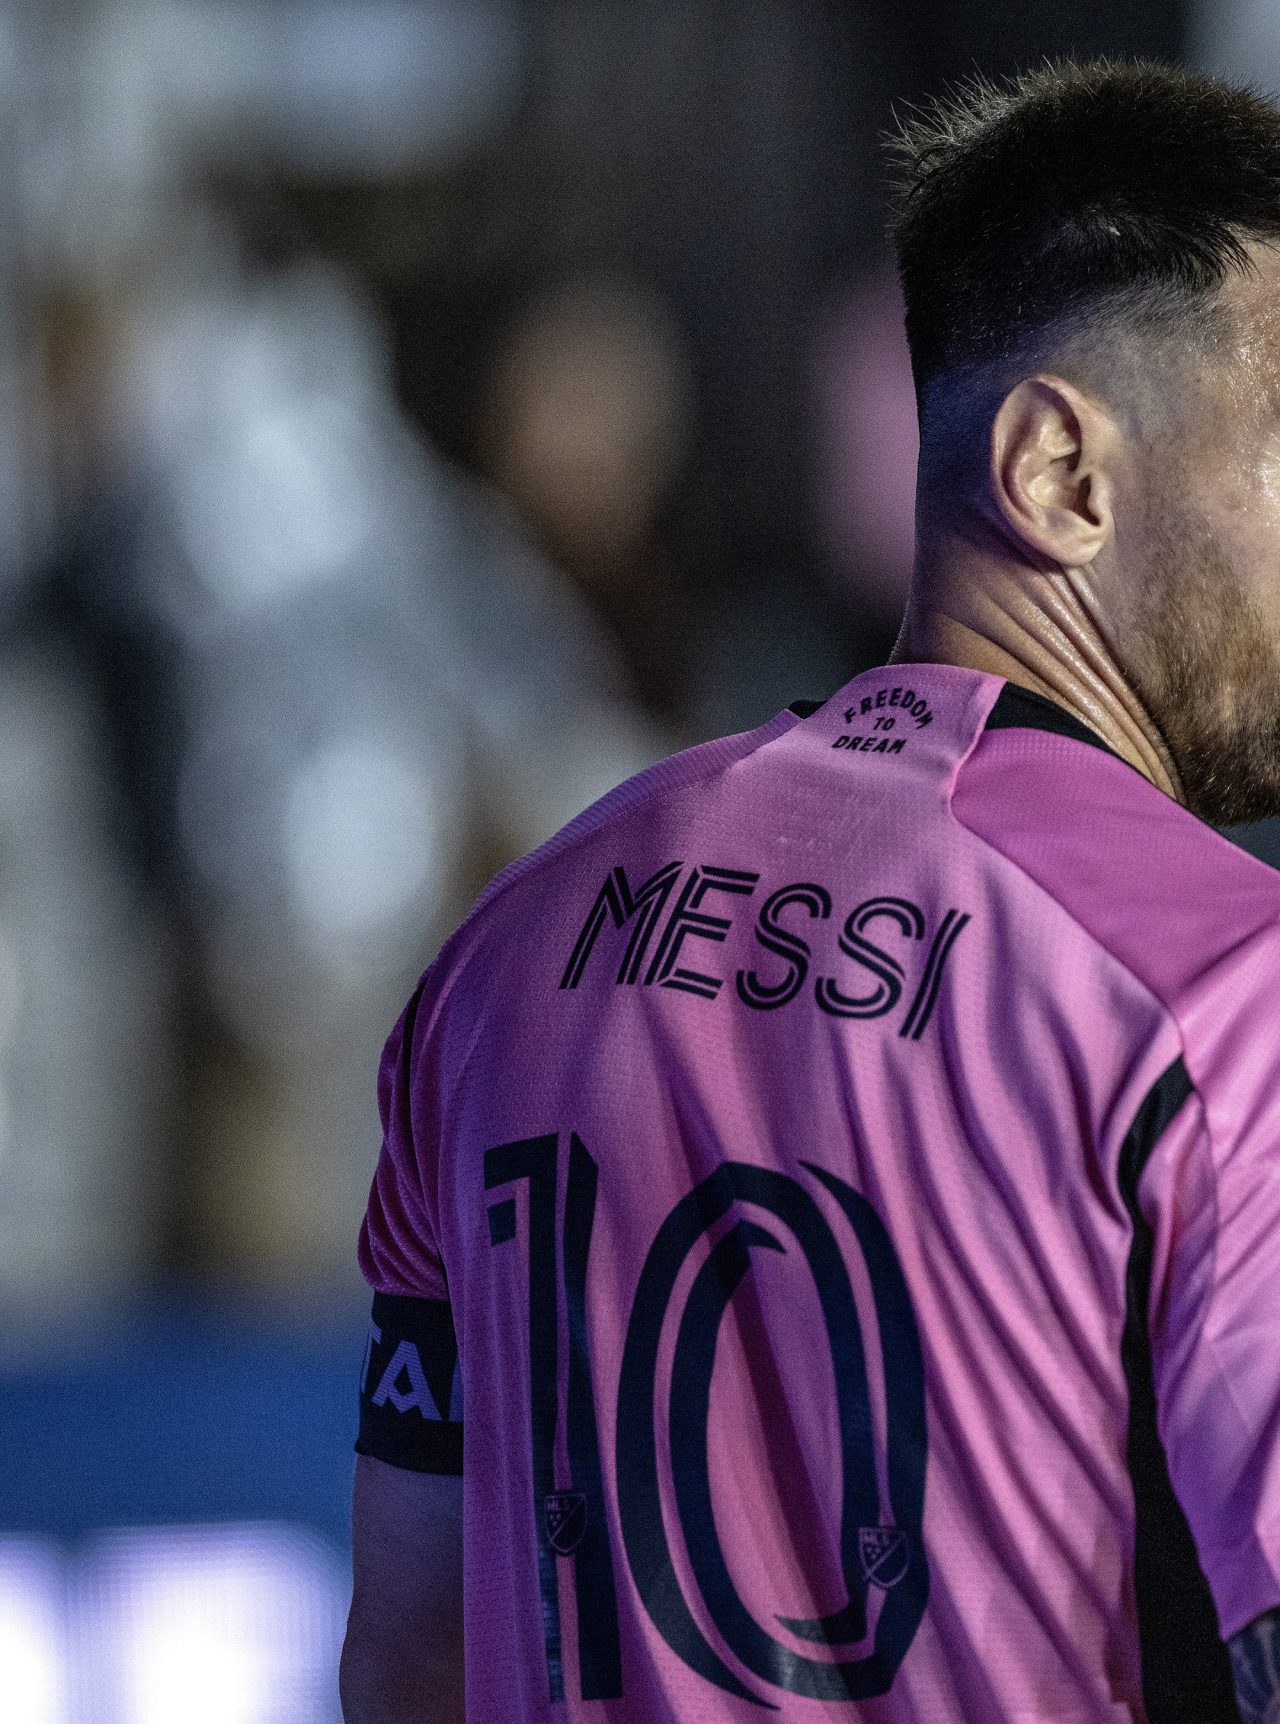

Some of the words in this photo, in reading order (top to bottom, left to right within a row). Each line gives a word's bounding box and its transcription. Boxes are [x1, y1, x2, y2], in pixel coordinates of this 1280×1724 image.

[844, 688, 933, 729] FREEDOM
[873, 717, 895, 731] TO
[832, 735, 907, 754] DREAM
[558, 861, 971, 1040] MESSI
[484, 1131, 930, 1710] 10
